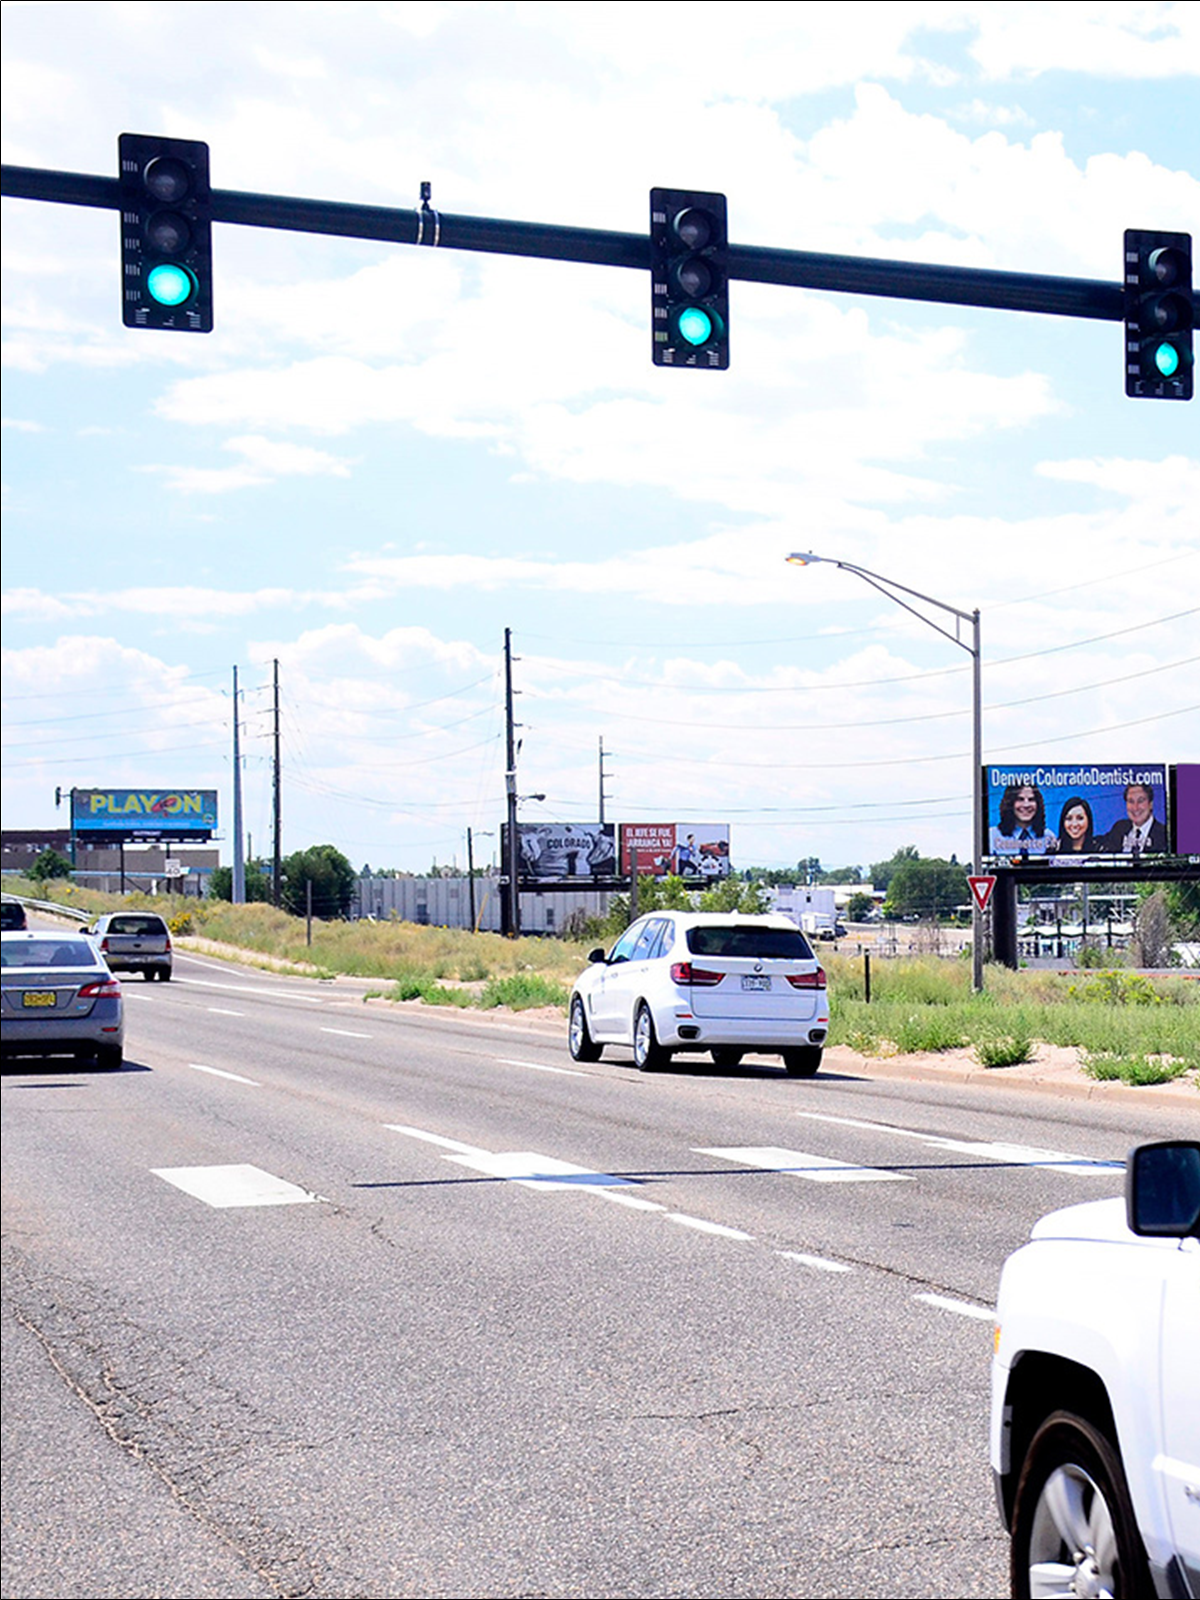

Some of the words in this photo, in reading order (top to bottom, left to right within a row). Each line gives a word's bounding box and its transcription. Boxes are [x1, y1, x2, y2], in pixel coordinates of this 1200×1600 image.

[991, 768, 1163, 786] DenverColoradoDentist.com
[90, 795, 158, 813] PLAY
[547, 838, 591, 849] COLORADO
